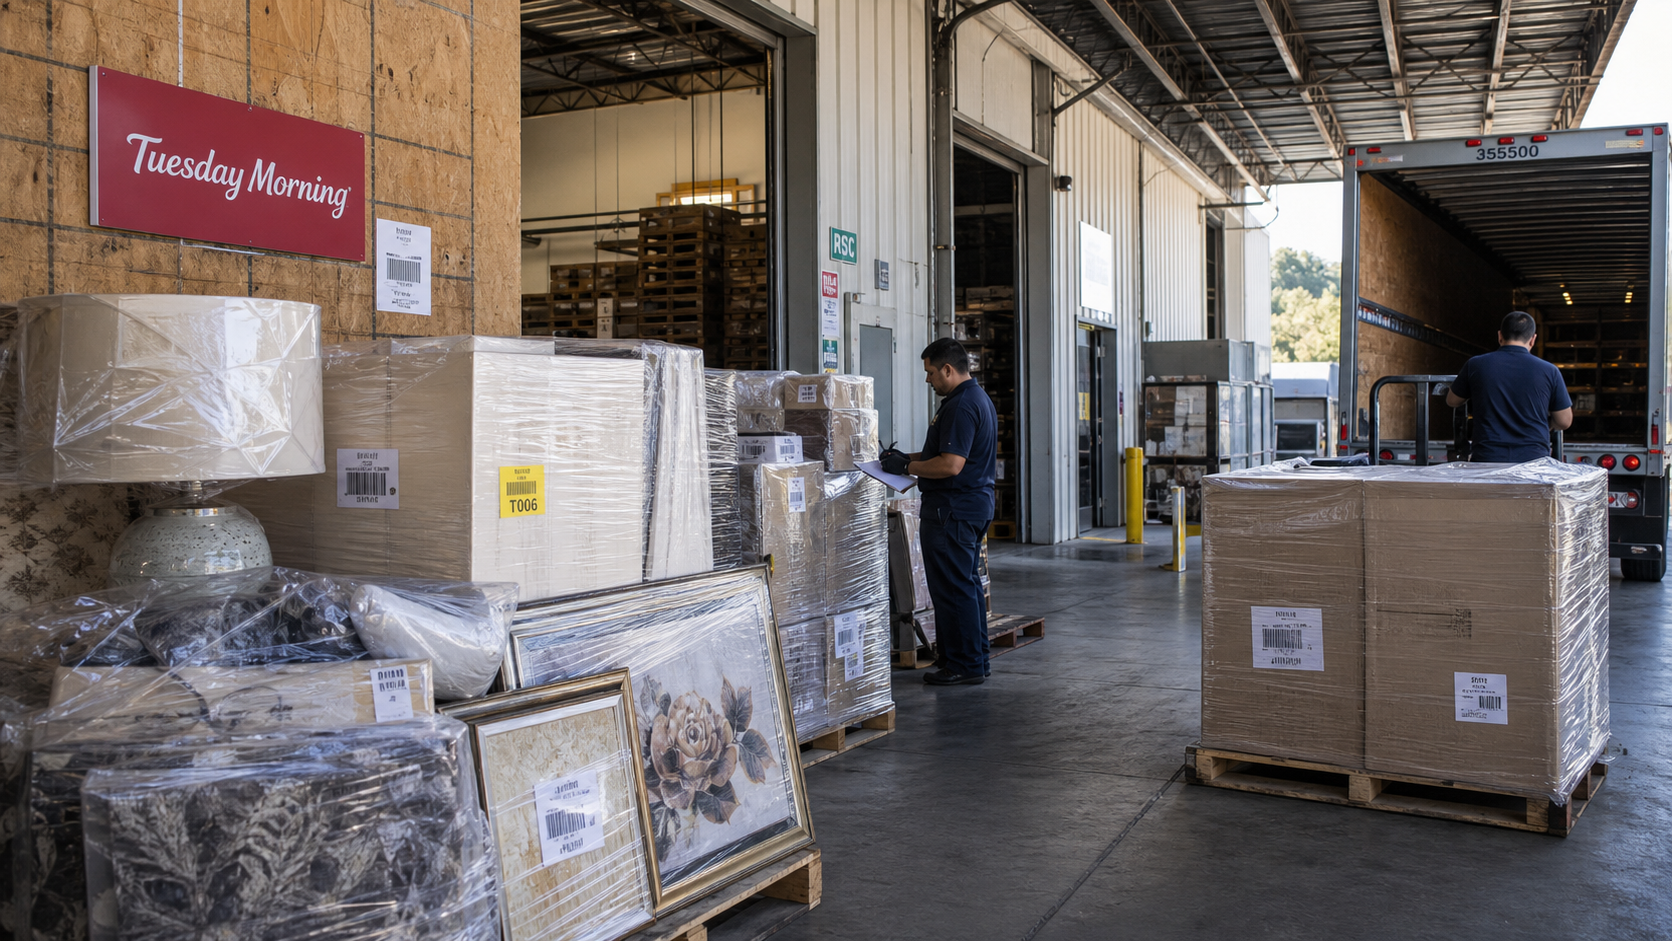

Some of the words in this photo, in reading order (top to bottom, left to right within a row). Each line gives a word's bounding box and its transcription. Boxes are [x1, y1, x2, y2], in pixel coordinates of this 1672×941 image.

[1476, 145, 1539, 161] 355500
[126, 133, 244, 201] Tuesday
[247, 158, 350, 219] Morning
[834, 232, 855, 258] RSC
[509, 498, 538, 513] T006
